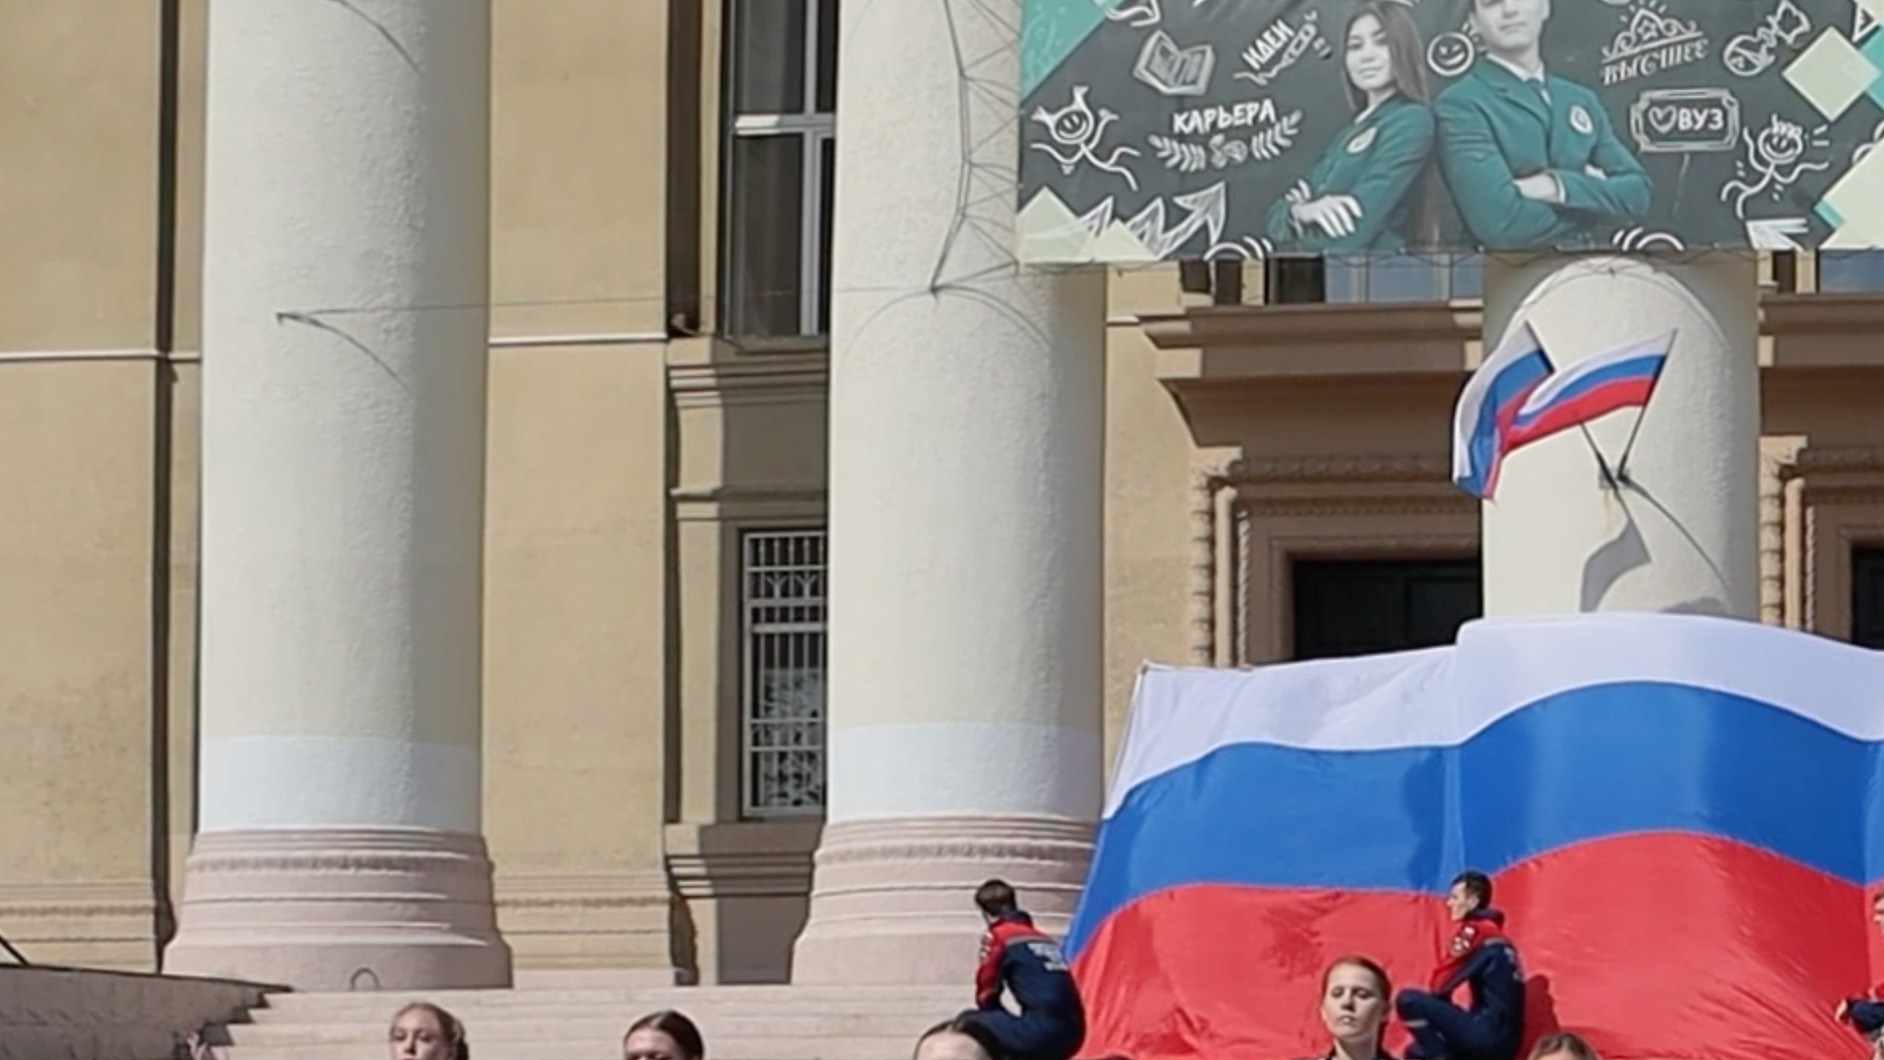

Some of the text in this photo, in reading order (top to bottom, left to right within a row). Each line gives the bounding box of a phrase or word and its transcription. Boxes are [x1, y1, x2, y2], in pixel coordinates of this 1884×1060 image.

[1242, 18, 1296, 70] ИДЕИ
[1172, 98, 1276, 135] КАРЬЕРА
[1679, 107, 1724, 131] ВУЗ
